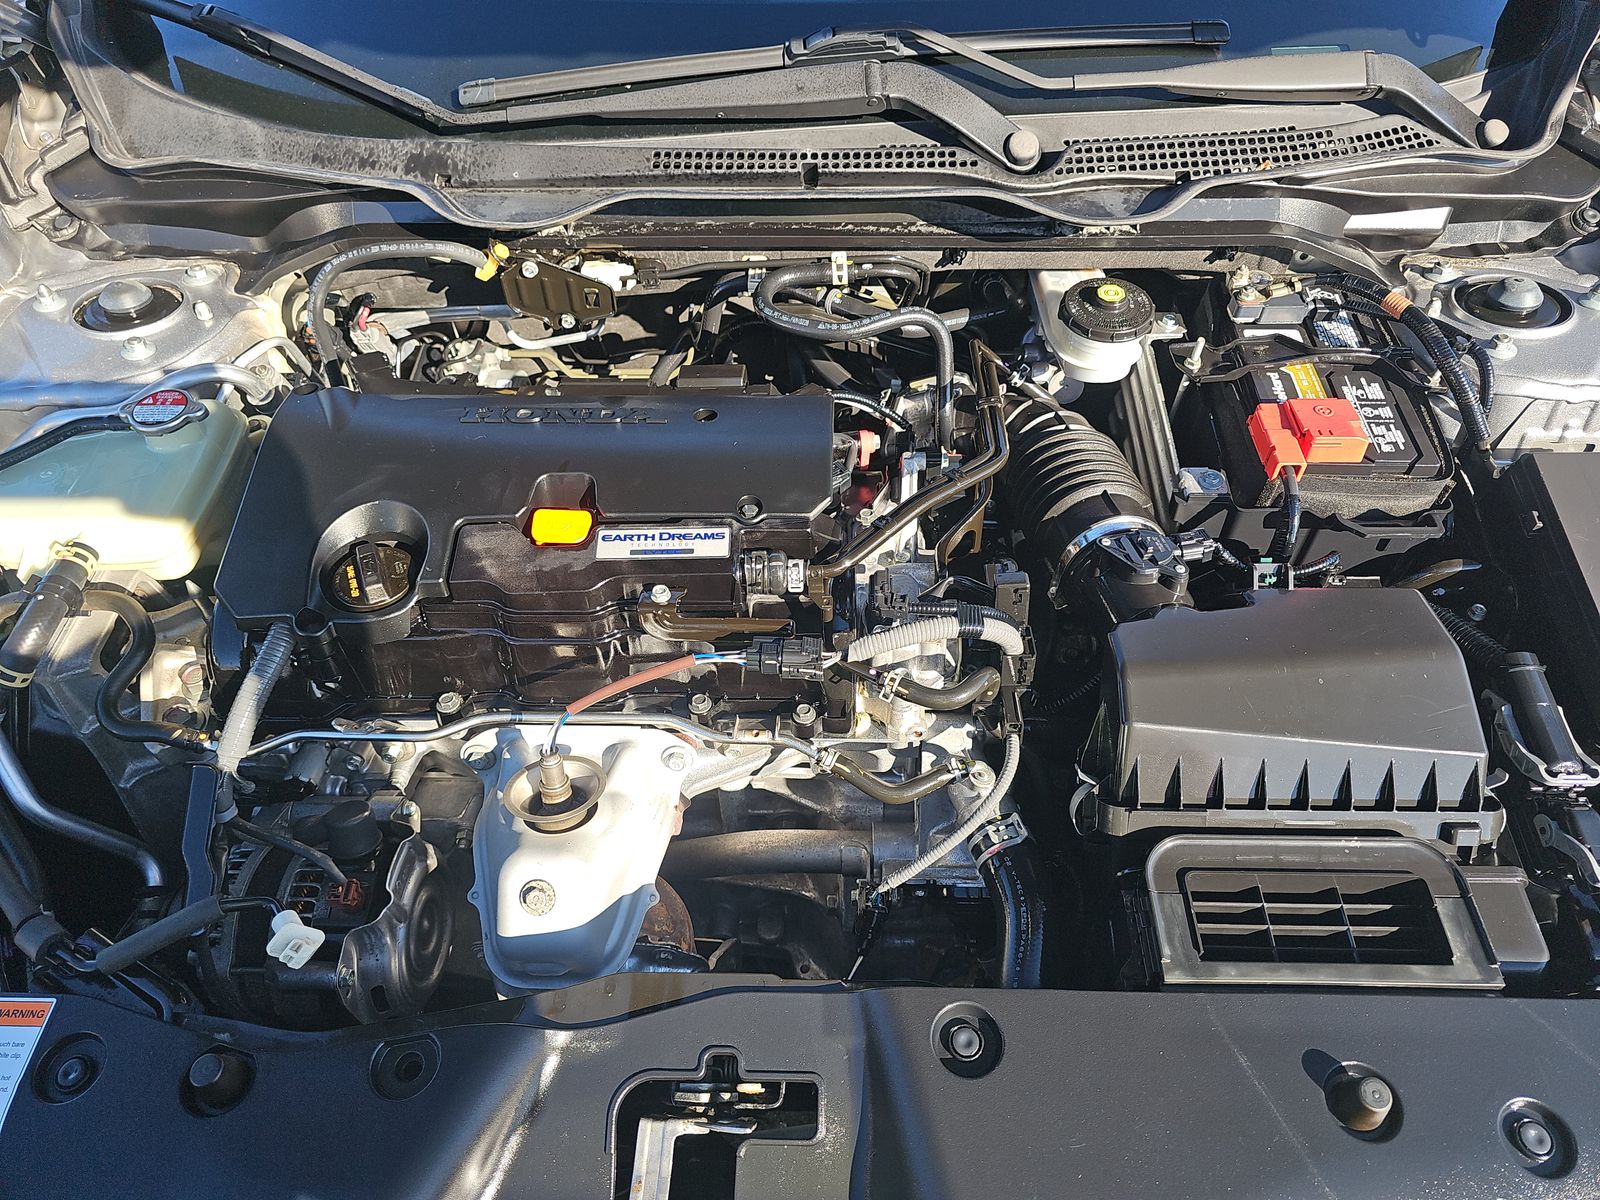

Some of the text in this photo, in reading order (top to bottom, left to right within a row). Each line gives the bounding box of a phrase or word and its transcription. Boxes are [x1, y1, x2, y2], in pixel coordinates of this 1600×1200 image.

[459, 407, 669, 424] HONDA
[601, 531, 726, 542] EARTH DREAMS
